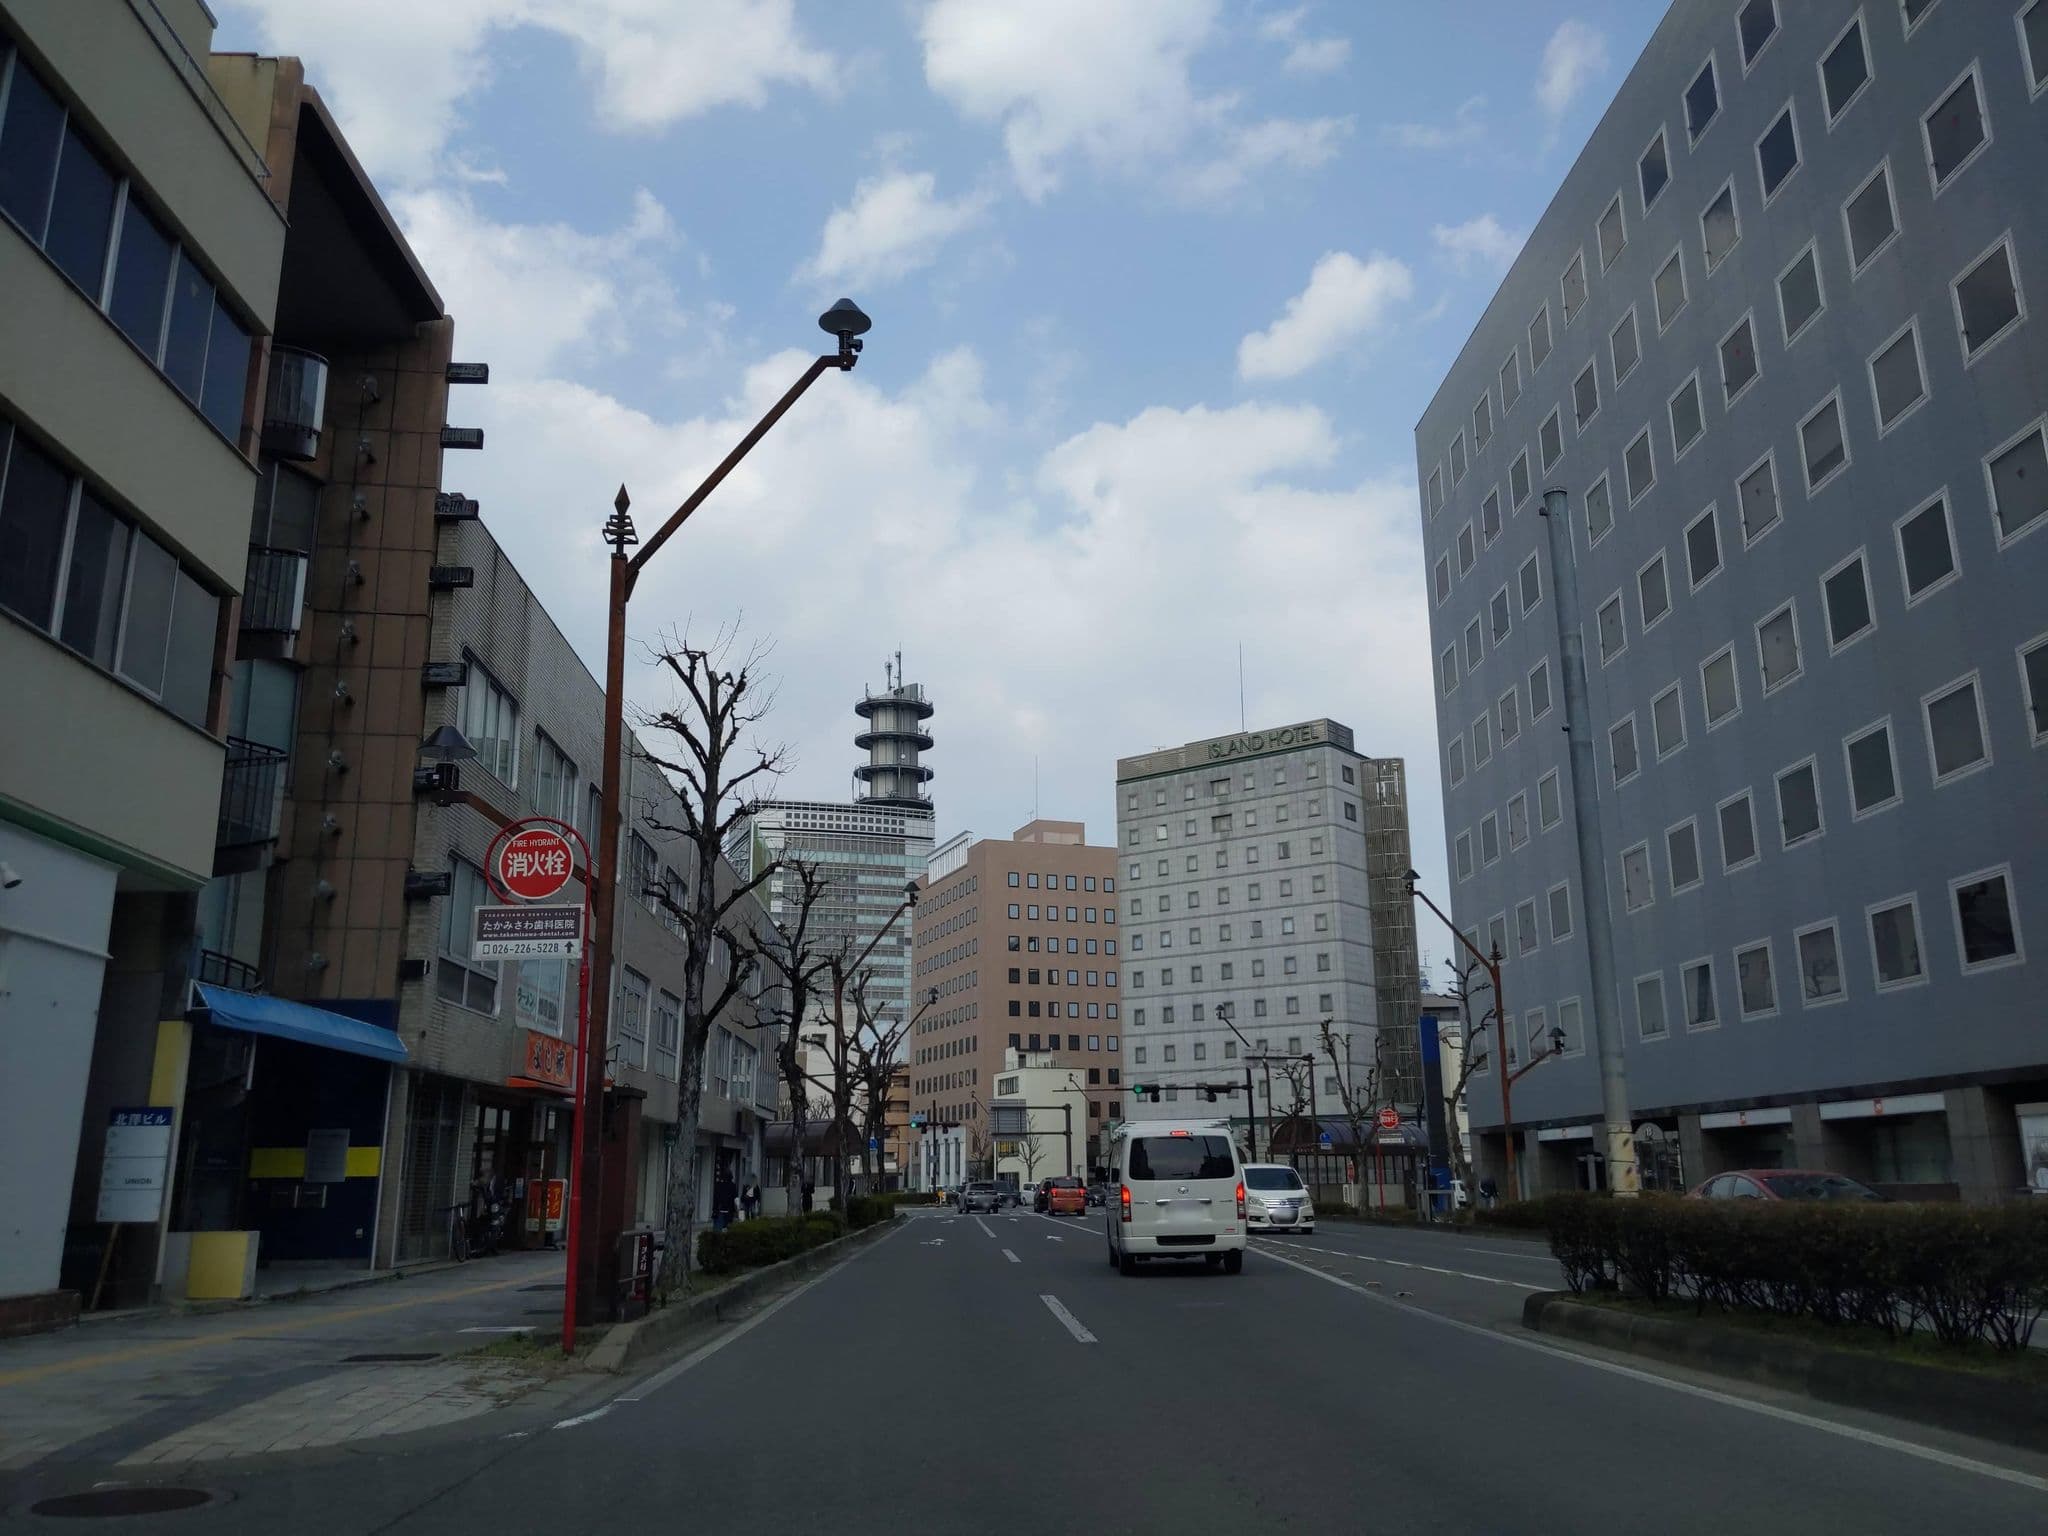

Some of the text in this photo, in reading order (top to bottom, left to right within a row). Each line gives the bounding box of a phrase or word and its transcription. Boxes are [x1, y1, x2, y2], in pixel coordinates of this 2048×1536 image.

[1208, 723, 1320, 759] ISLAND HOTEL
[512, 837, 561, 848] FIRE HYDRANT
[507, 849, 567, 878] 消火栓
[482, 919, 576, 931] たかみさわ歯科医院
[492, 943, 559, 954] 026-226-5228
